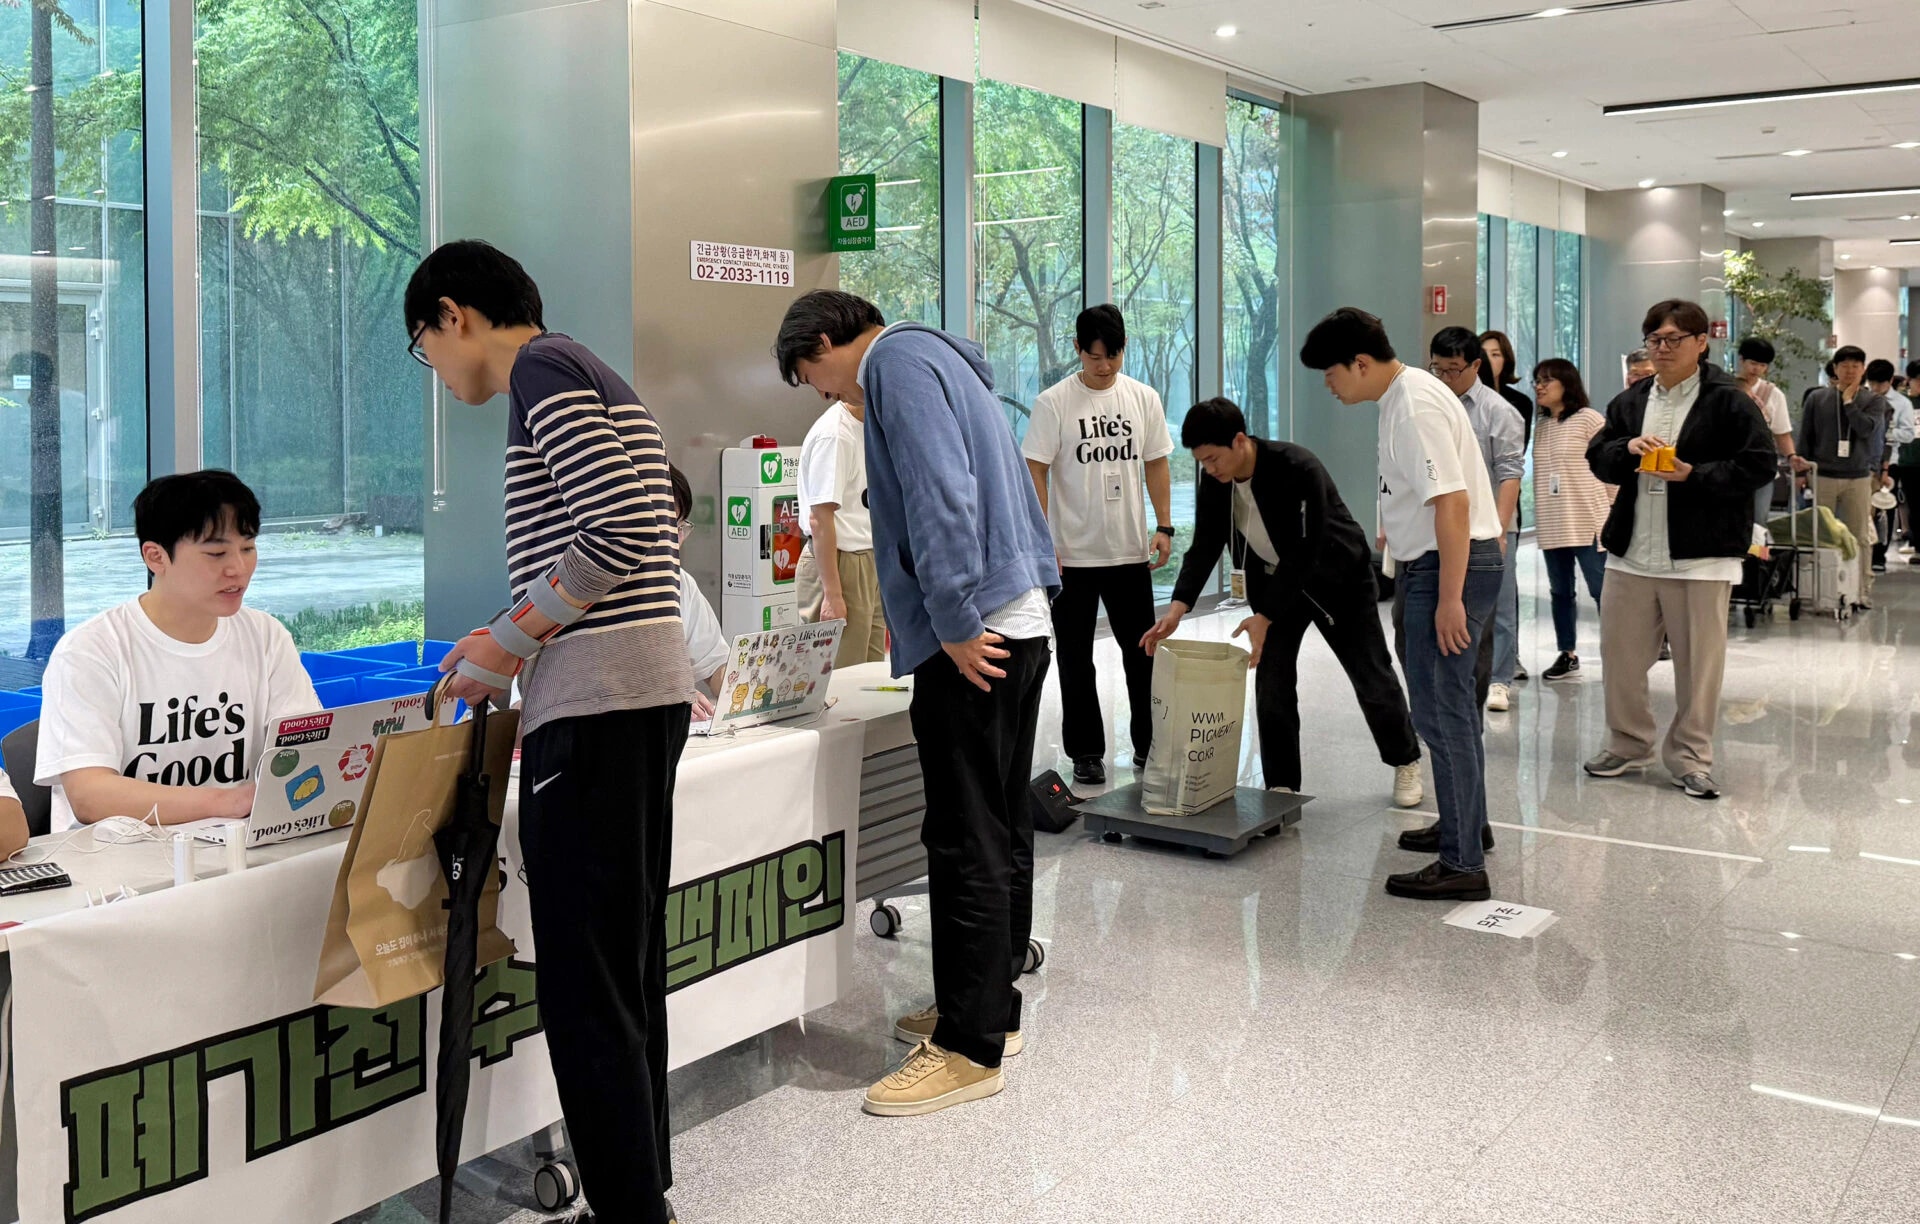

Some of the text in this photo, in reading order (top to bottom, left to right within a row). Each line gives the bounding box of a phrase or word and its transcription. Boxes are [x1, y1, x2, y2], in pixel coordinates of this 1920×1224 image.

[845, 217, 866, 228] AED
[779, 251, 790, 263] 등)
[697, 264, 789, 285] 02-2033-1119
[1078, 413, 1132, 440] Life's
[1076, 438, 1138, 464] Good.
[780, 500, 800, 518] AE
[731, 527, 749, 537] AED
[799, 626, 838, 641] Life's Good.
[391, 696, 426, 714] Good.
[137, 691, 246, 746] Life's
[282, 714, 332, 731] Life's Good.
[279, 728, 327, 745] Life's Good.
[252, 813, 326, 841] Life's Good.
[470, 938, 546, 1070] 수
